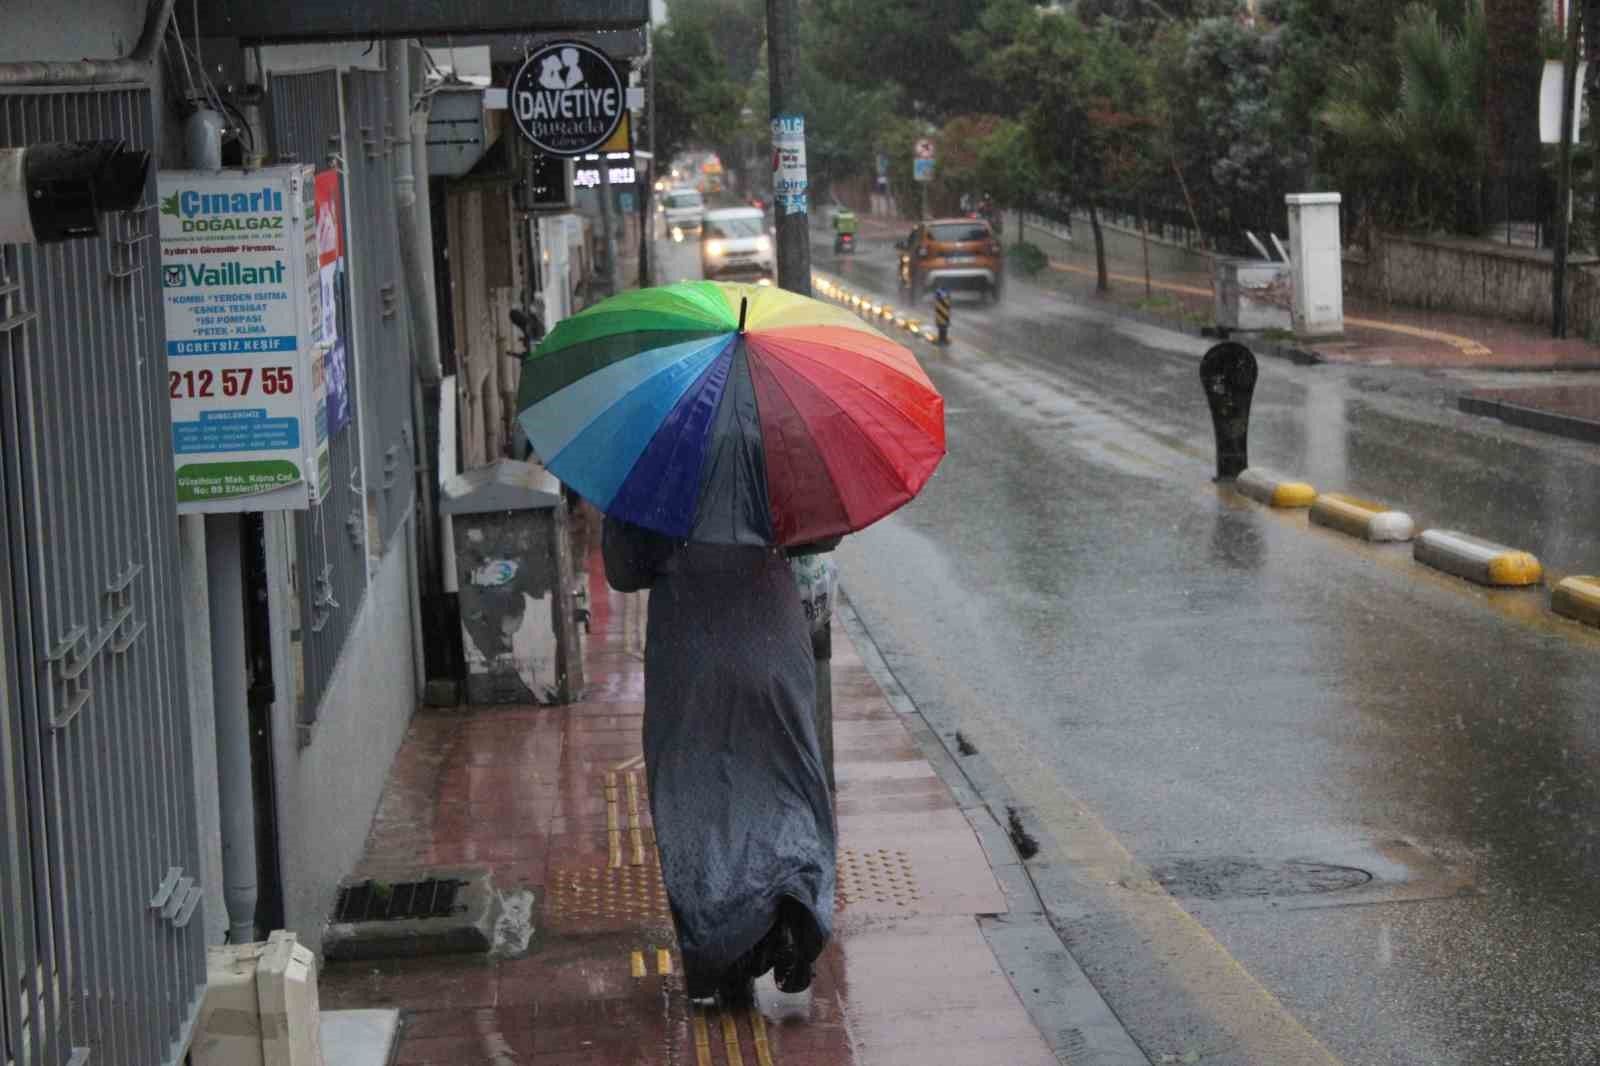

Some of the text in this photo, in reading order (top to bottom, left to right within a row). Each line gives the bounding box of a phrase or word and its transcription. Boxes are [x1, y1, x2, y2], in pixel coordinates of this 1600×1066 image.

[518, 83, 616, 120] DAVETİYE
[181, 188, 282, 218] Çınarlı
[182, 215, 284, 233] DOĞALGAZ
[187, 259, 286, 287] Vaillant
[177, 338, 281, 354] ÜCRETSİZ KEŞİF
[167, 366, 294, 399] 212 57 55
